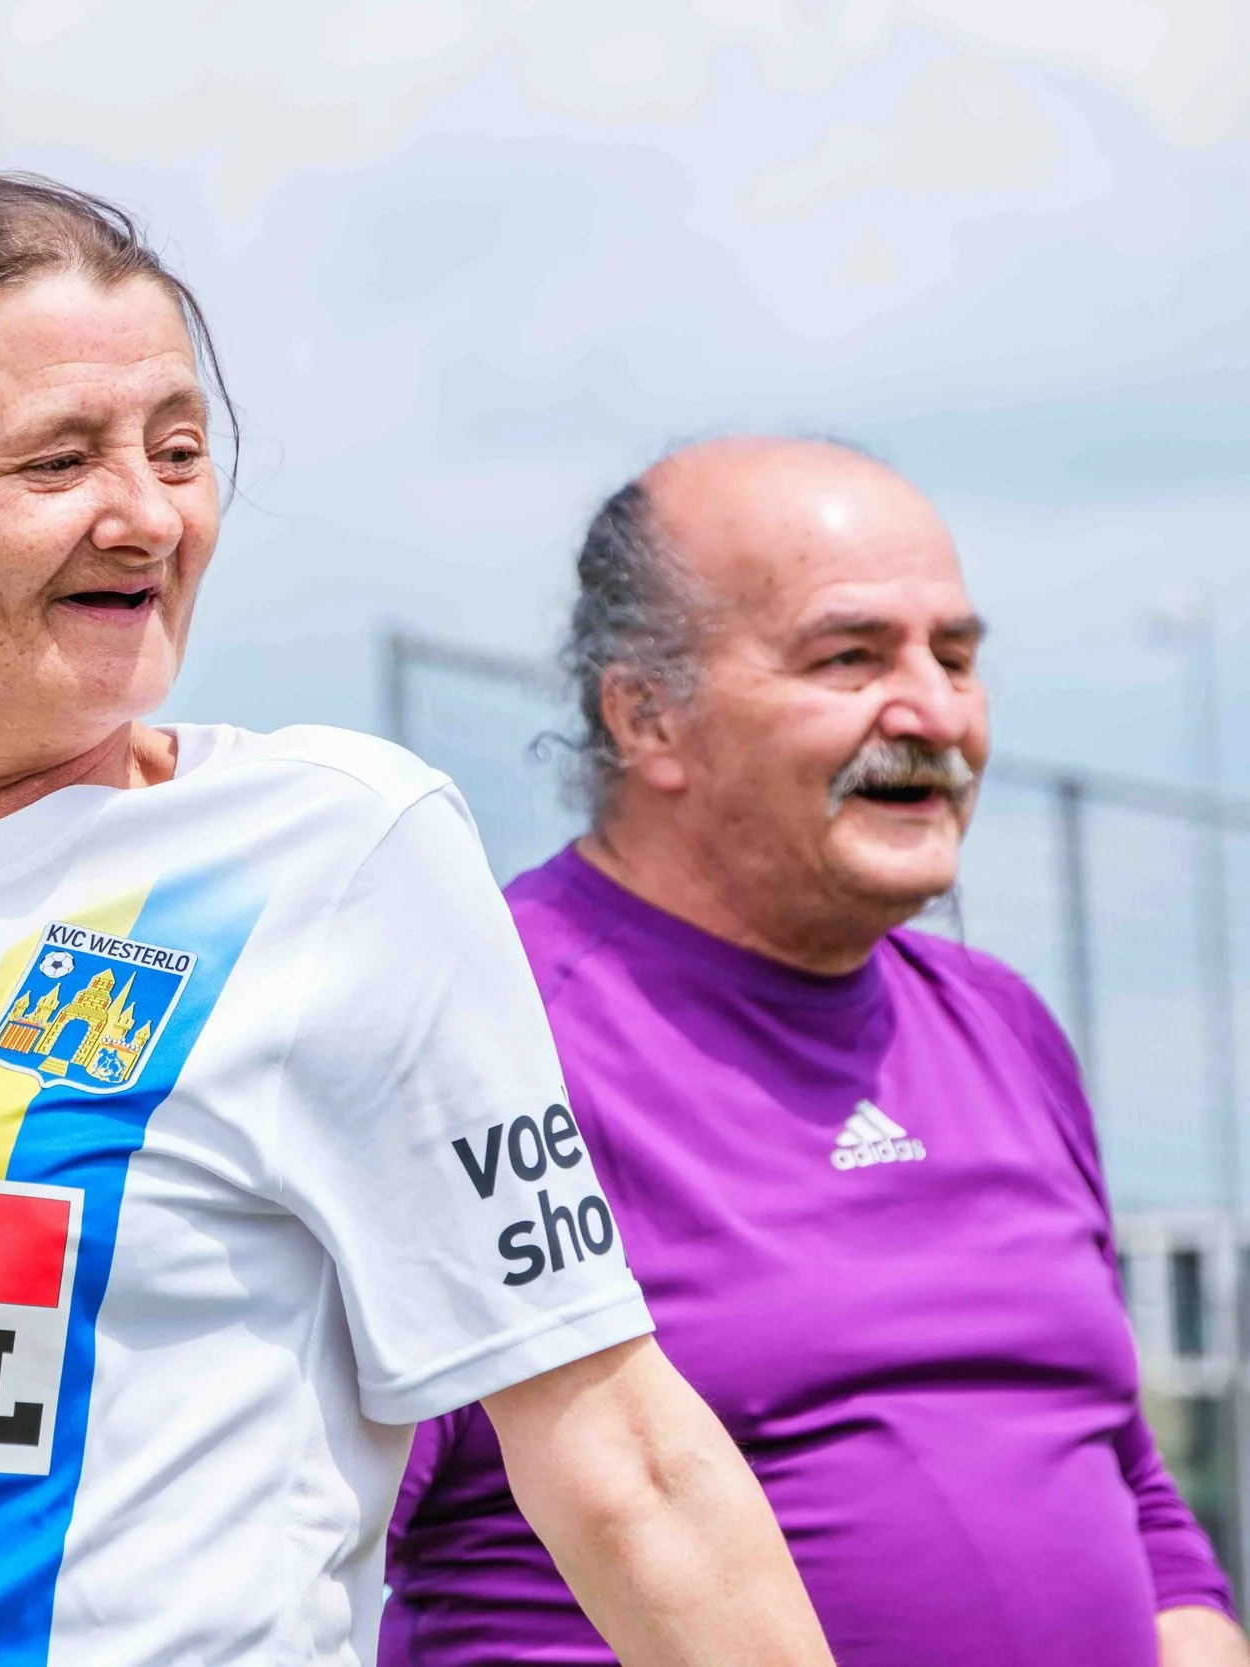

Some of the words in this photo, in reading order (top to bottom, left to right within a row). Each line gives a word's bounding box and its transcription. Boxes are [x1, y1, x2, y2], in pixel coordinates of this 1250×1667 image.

[46, 924, 87, 948] KVC
[89, 933, 190, 973] WESTERLO
[451, 1100, 583, 1200] voe
[830, 1137, 927, 1171] adidas
[498, 1188, 615, 1286] sho
